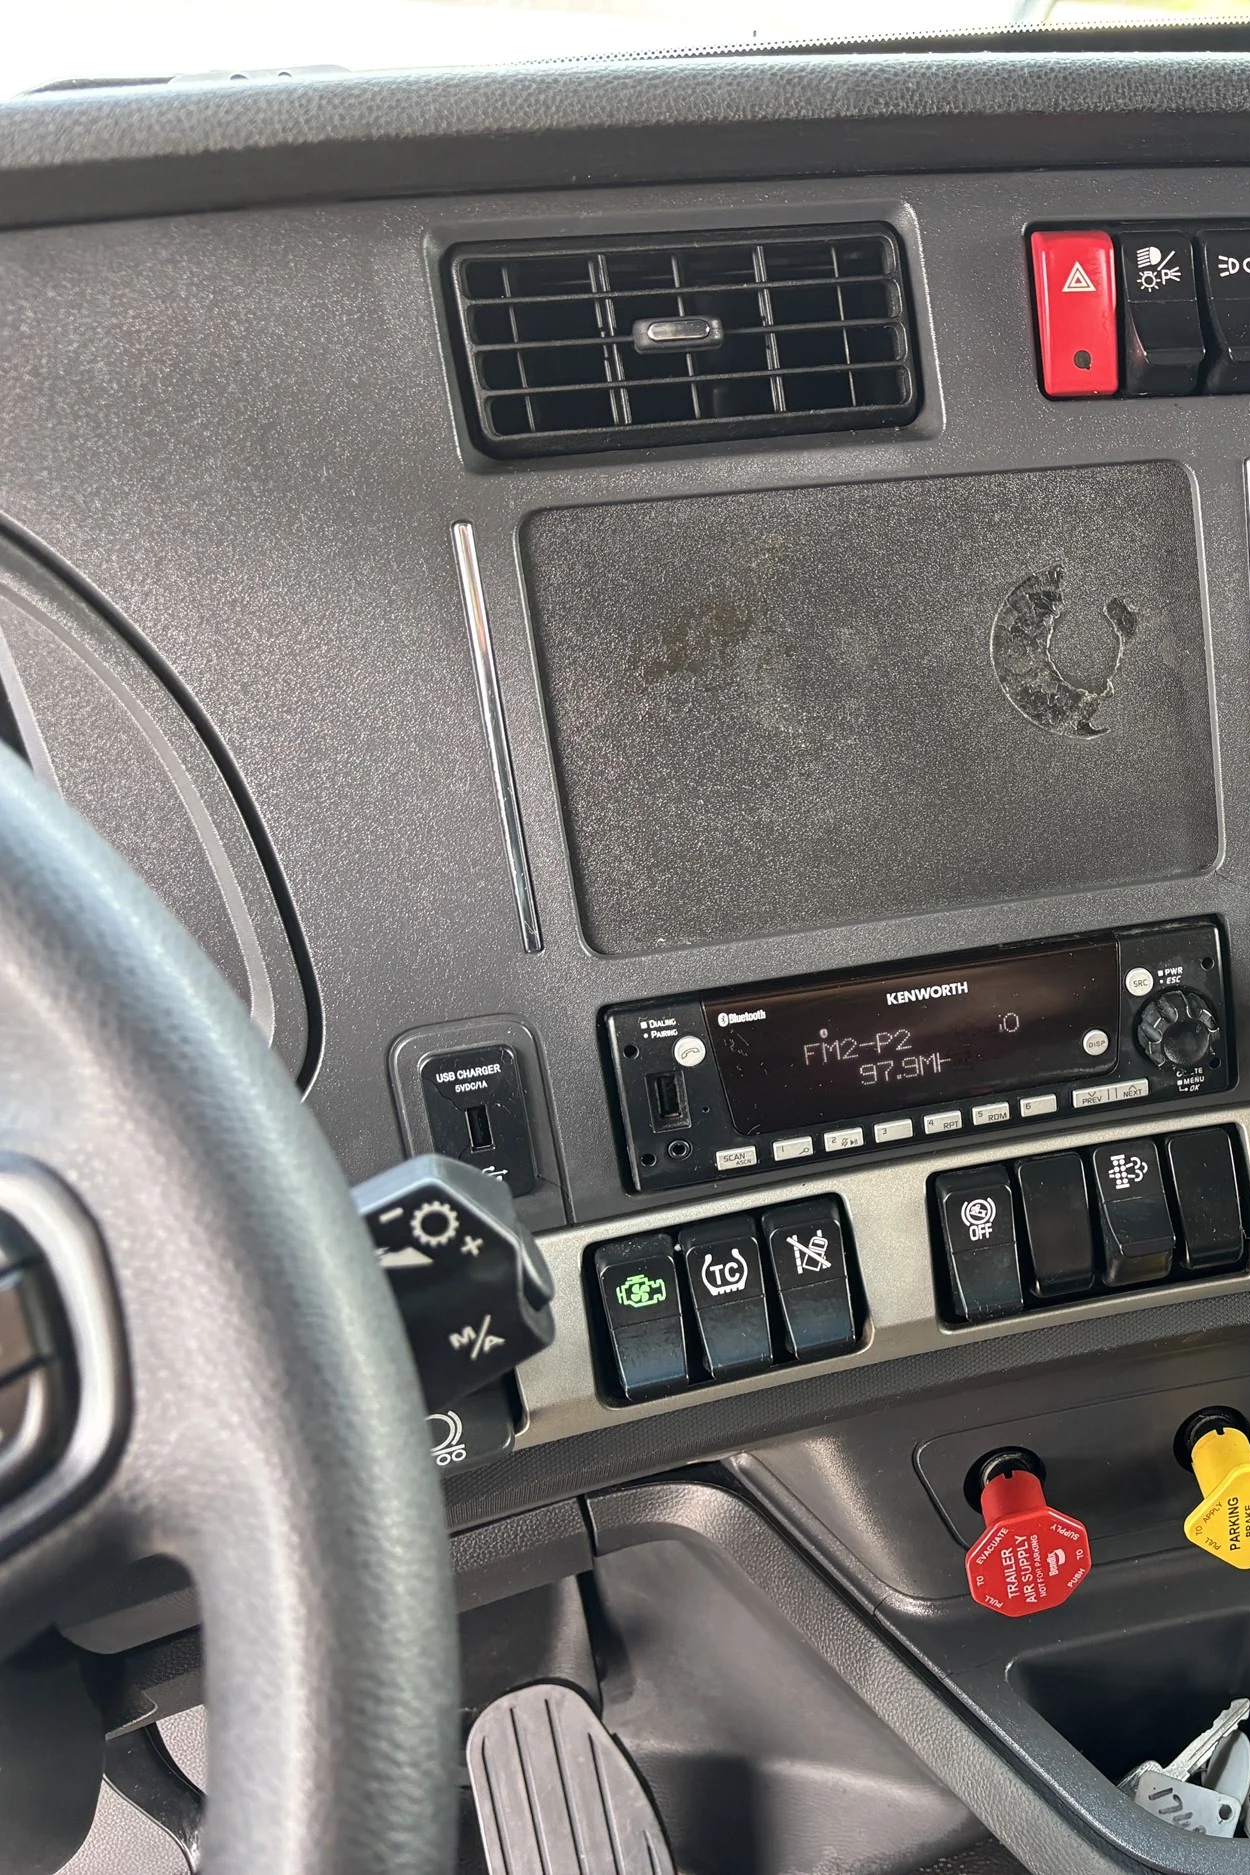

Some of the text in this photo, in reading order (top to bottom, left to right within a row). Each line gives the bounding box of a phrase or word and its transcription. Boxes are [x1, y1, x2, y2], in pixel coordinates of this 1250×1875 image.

[1165, 967, 1183, 976] PWR
[1133, 978, 1148, 988] SRC
[1166, 976, 1181, 985] ESC
[886, 981, 968, 1005] KENWORTH
[729, 1010, 766, 1024] Bluetooth
[804, 1029, 912, 1065] FM2-P2
[1088, 1040, 1106, 1049] DISP
[436, 1063, 501, 1083] USB CHARGER
[1183, 1075, 1205, 1085] MENU
[455, 1080, 488, 1093] 5VDC/1A
[1189, 1083, 1200, 1092] OK
[1123, 1088, 1143, 1098] NEXT
[1025, 1102, 1032, 1110] 6
[1082, 1095, 1103, 1105] PREV
[977, 1110, 984, 1118] 5
[988, 1111, 1008, 1122] RDM
[928, 1119, 934, 1127] 4
[943, 1120, 960, 1130] RPT
[882, 1127, 888, 1135] 3
[831, 1136, 837, 1144] 2
[723, 1152, 746, 1162] SCAN
[969, 1224, 993, 1241] OFF
[710, 1261, 740, 1285] TC
[448, 1314, 506, 1361] M/A
[1195, 1501, 1223, 1551] PULL TO APPLY
[1227, 1496, 1241, 1552] PARKING
[1050, 1523, 1086, 1588] PUSH TO SUPPLY
[976, 1527, 1009, 1609] PULL TO EVACUATE
[1014, 1535, 1037, 1603] AIR SUPPLY
[1030, 1534, 1047, 1598] NOT FOR PARKING
[1047, 1552, 1059, 1576] Bendix
[1001, 1547, 1020, 1599] TRAILER
